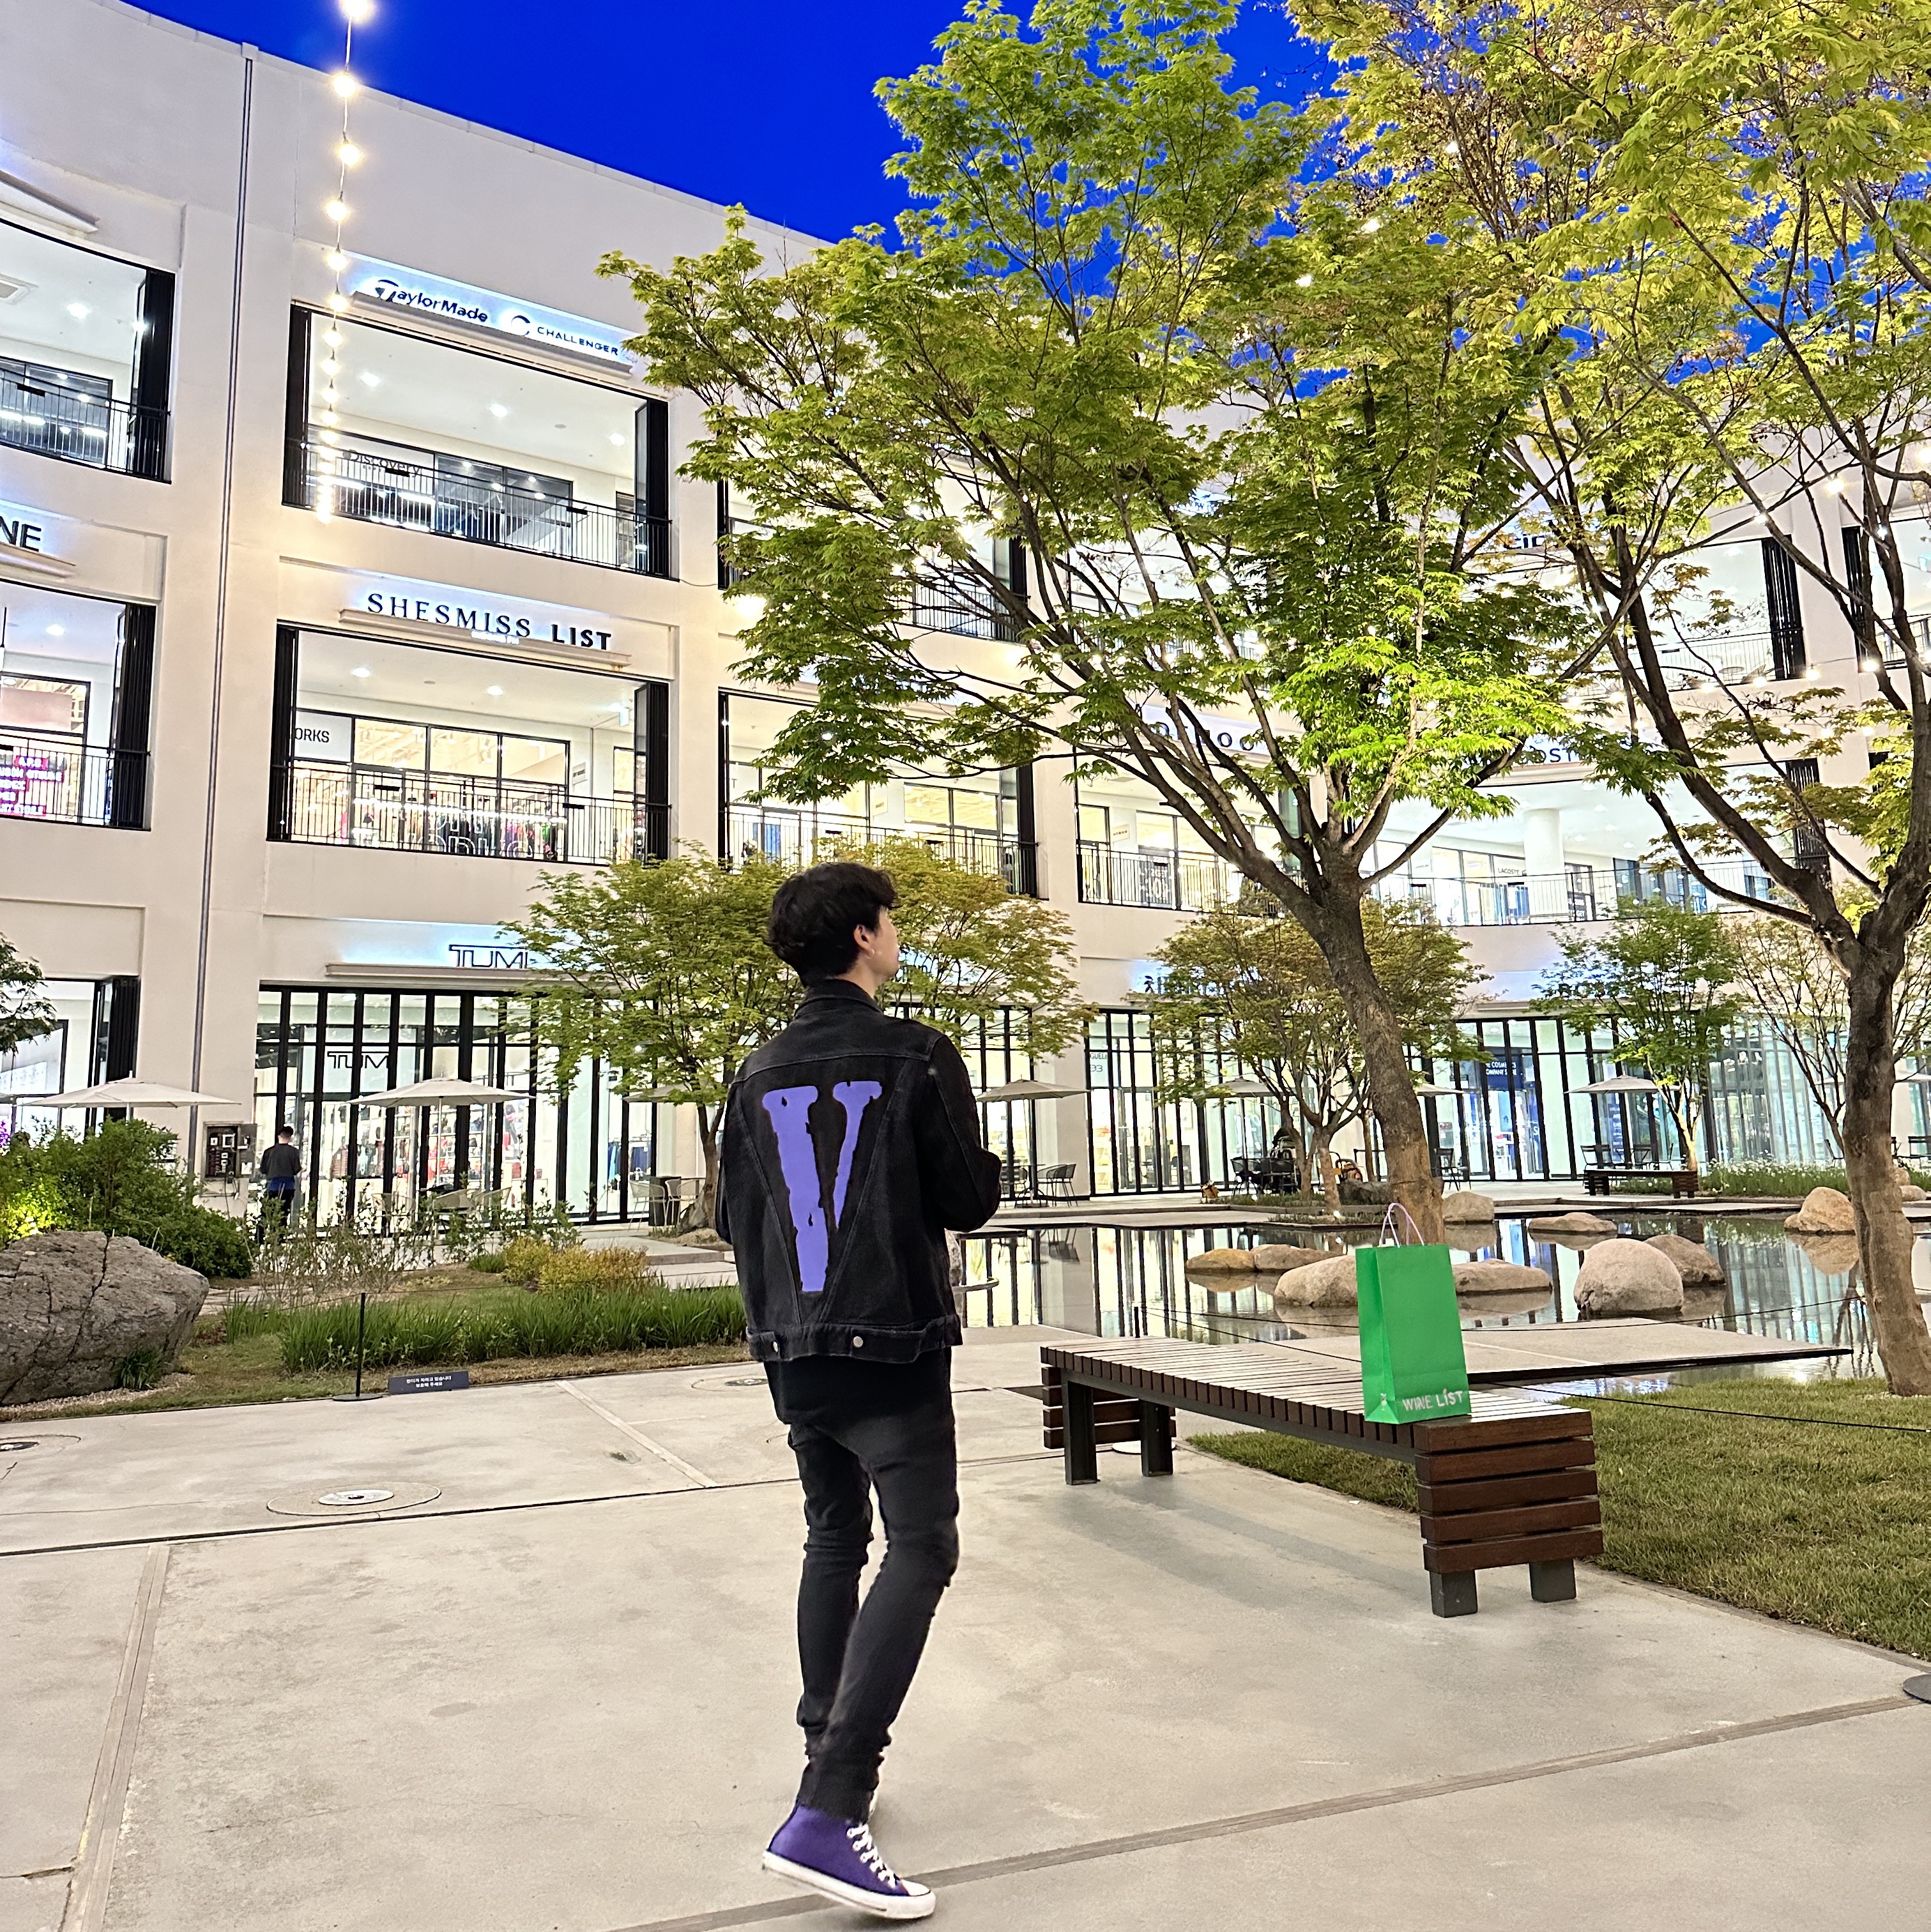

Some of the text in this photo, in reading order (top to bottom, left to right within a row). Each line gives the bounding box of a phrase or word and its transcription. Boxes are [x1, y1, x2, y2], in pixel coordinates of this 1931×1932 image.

[374, 279, 488, 323] TaylorMade
[537, 326, 618, 356] CHALLENGER
[367, 593, 531, 637] SHESMISS
[551, 624, 612, 651] LIST
[448, 944, 529, 970] TUMI
[762, 1080, 883, 1293] V
